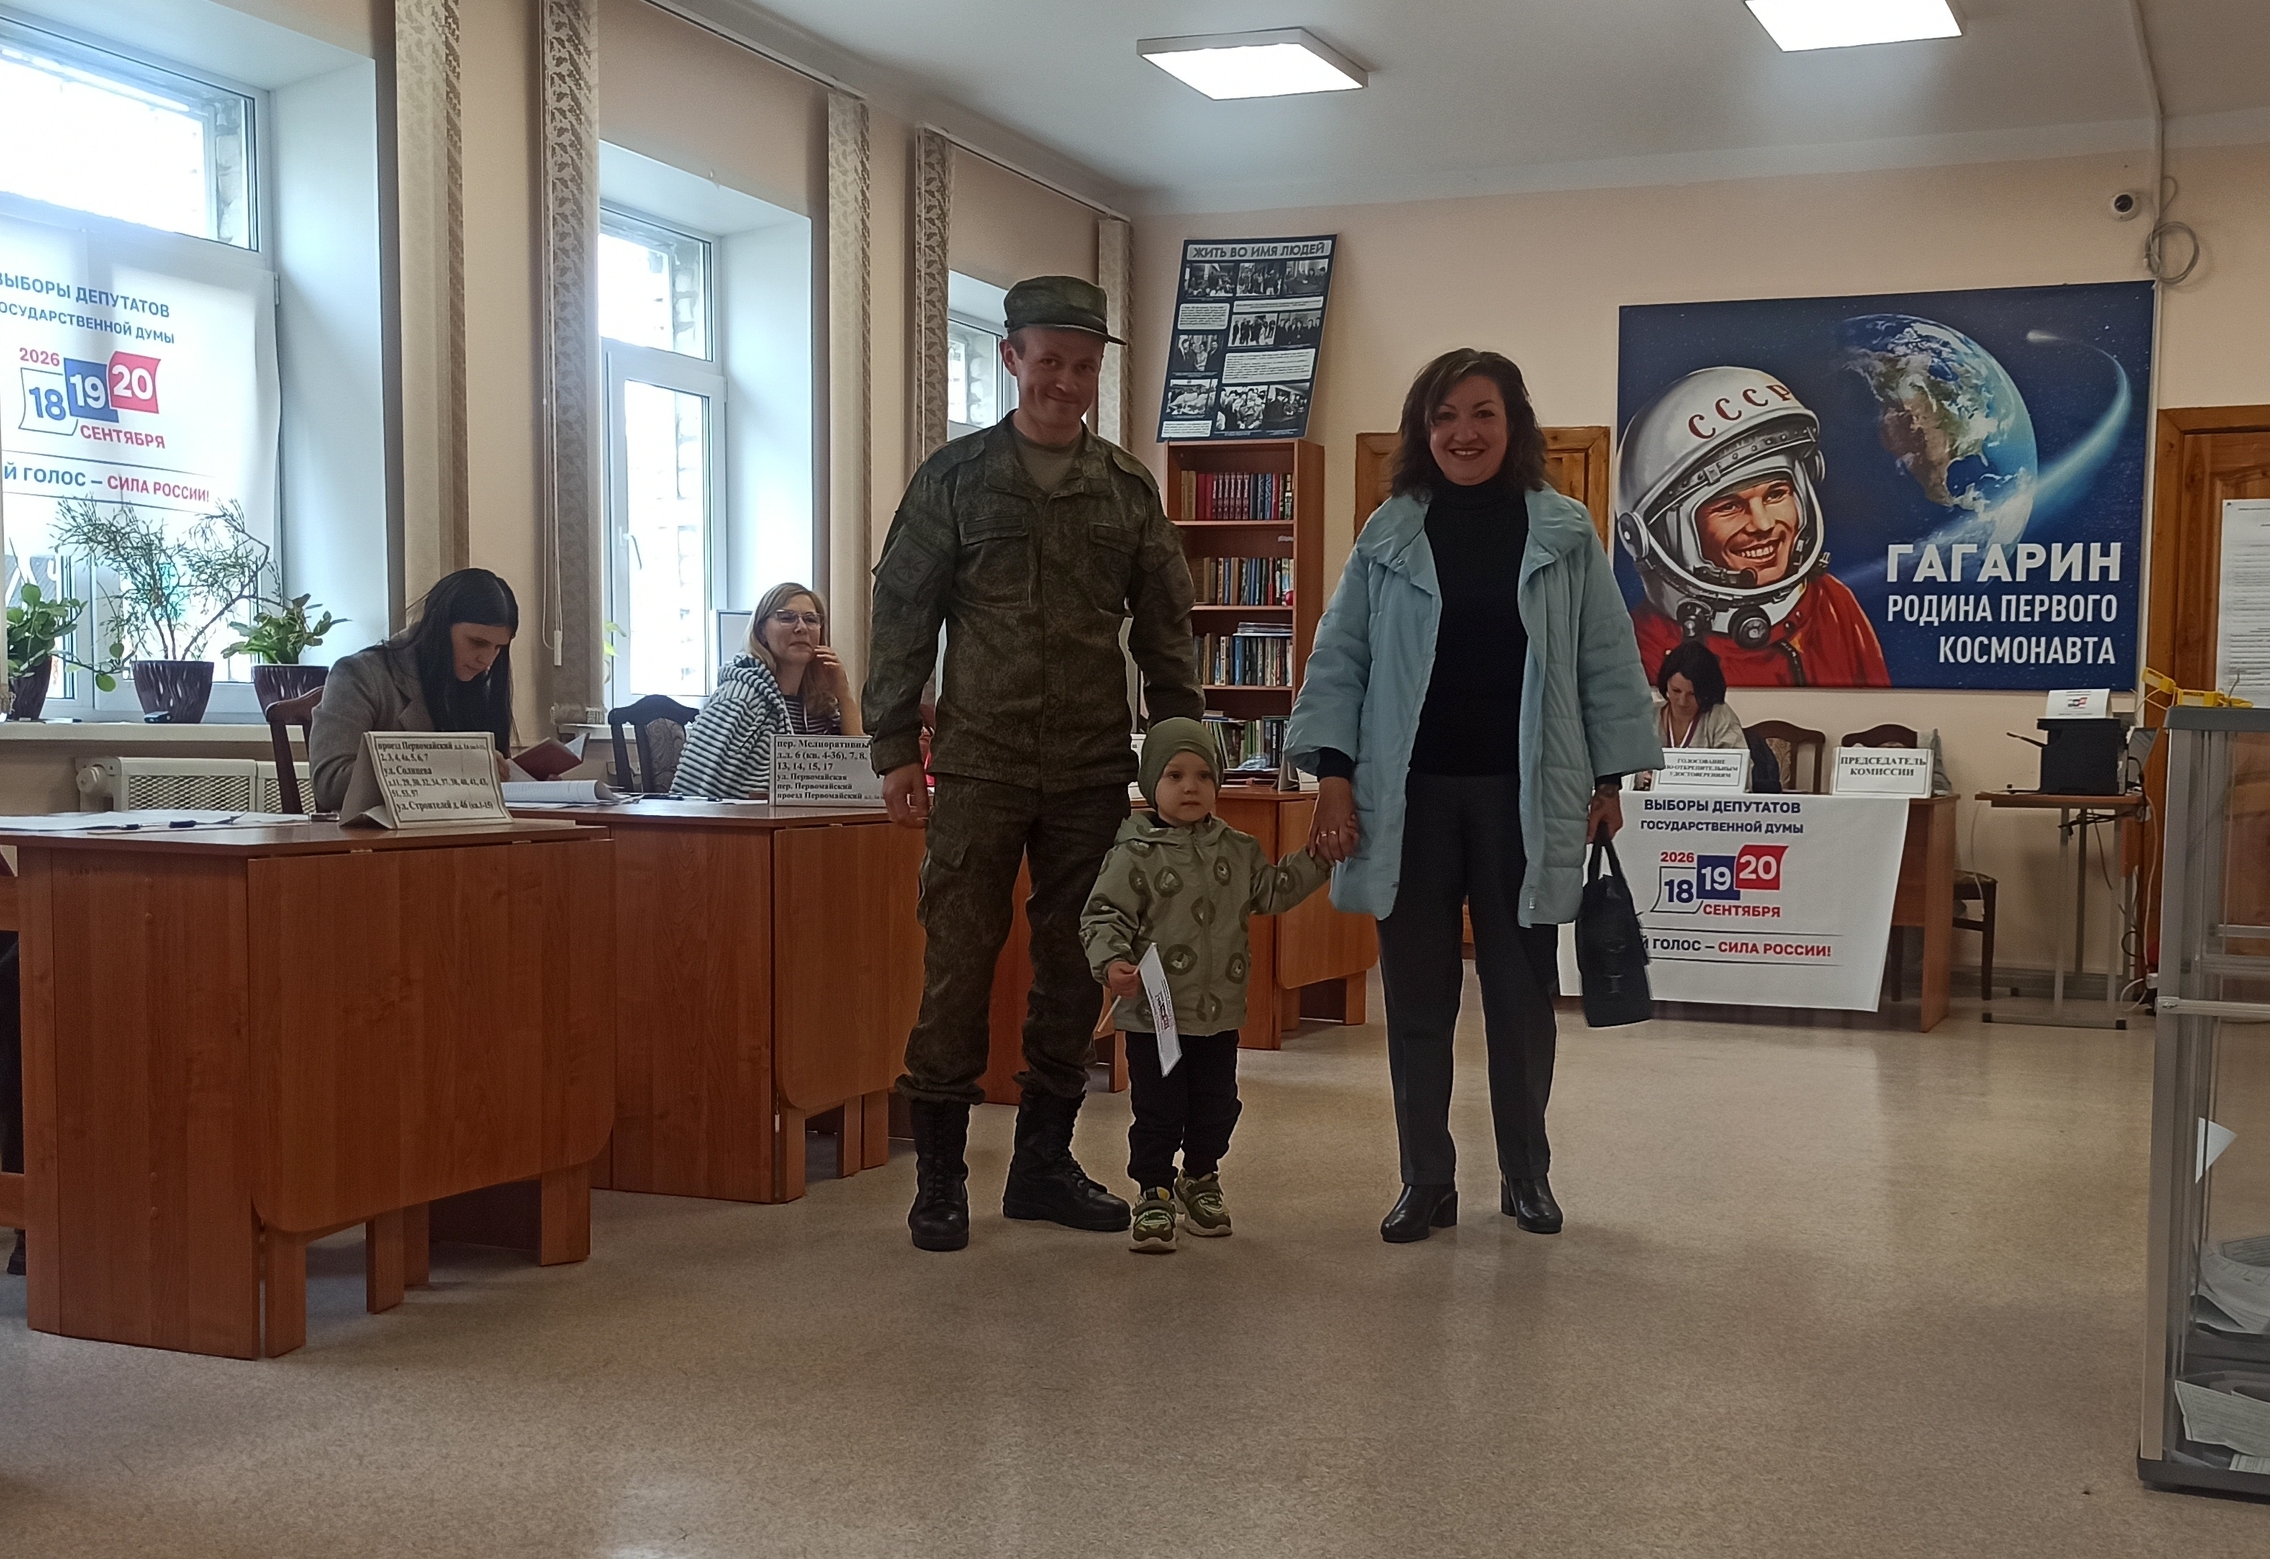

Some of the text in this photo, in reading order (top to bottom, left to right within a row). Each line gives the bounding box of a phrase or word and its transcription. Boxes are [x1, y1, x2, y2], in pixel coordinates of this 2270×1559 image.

[1193, 242, 1325, 258] ЖИТЬ ВО ИМЯ ЛЮДЕЙ
[76, 286, 170, 318] ДЕПУТАТОВ
[0, 301, 175, 344] ОСУДАРСТВЕННОЙ ДУМЫ
[19, 347, 60, 367] 2026
[29, 364, 154, 421] 18 19 20
[1688, 382, 1791, 439] СССР
[80, 425, 165, 449] СЕНТЯБРЯ
[23, 467, 86, 487] ГОЛОС
[107, 475, 150, 494] СИЛА
[153, 481, 209, 502] РОССИИ!
[1887, 542, 2121, 582] ГАГАРИН
[1887, 594, 2118, 626] РОДИНА ПЕРВОГО
[1939, 636, 2116, 664] КОСМОНАВТА
[798, 739, 870, 750] Мелиоративны
[1840, 756, 1927, 765] ПРЕДСЕДАТЕЛЬ
[1850, 768, 1914, 776] КОМИССИИ
[805, 792, 862, 800] Первомайский
[1644, 799, 1801, 814] ВЫБОРЫ ДЕПУТАТОВ
[1640, 820, 1804, 834] ГОСУДАРСТВЕННОЙ ДУМЫ
[1660, 852, 1694, 863] 2026
[1664, 855, 1778, 903] 18 19 20
[1703, 904, 1781, 917] СЕНТЯБРЯ
[1653, 938, 1701, 951] ГОЛОС
[1718, 941, 1760, 954] СИЛА
[1763, 943, 1831, 957] РОССИИ!
